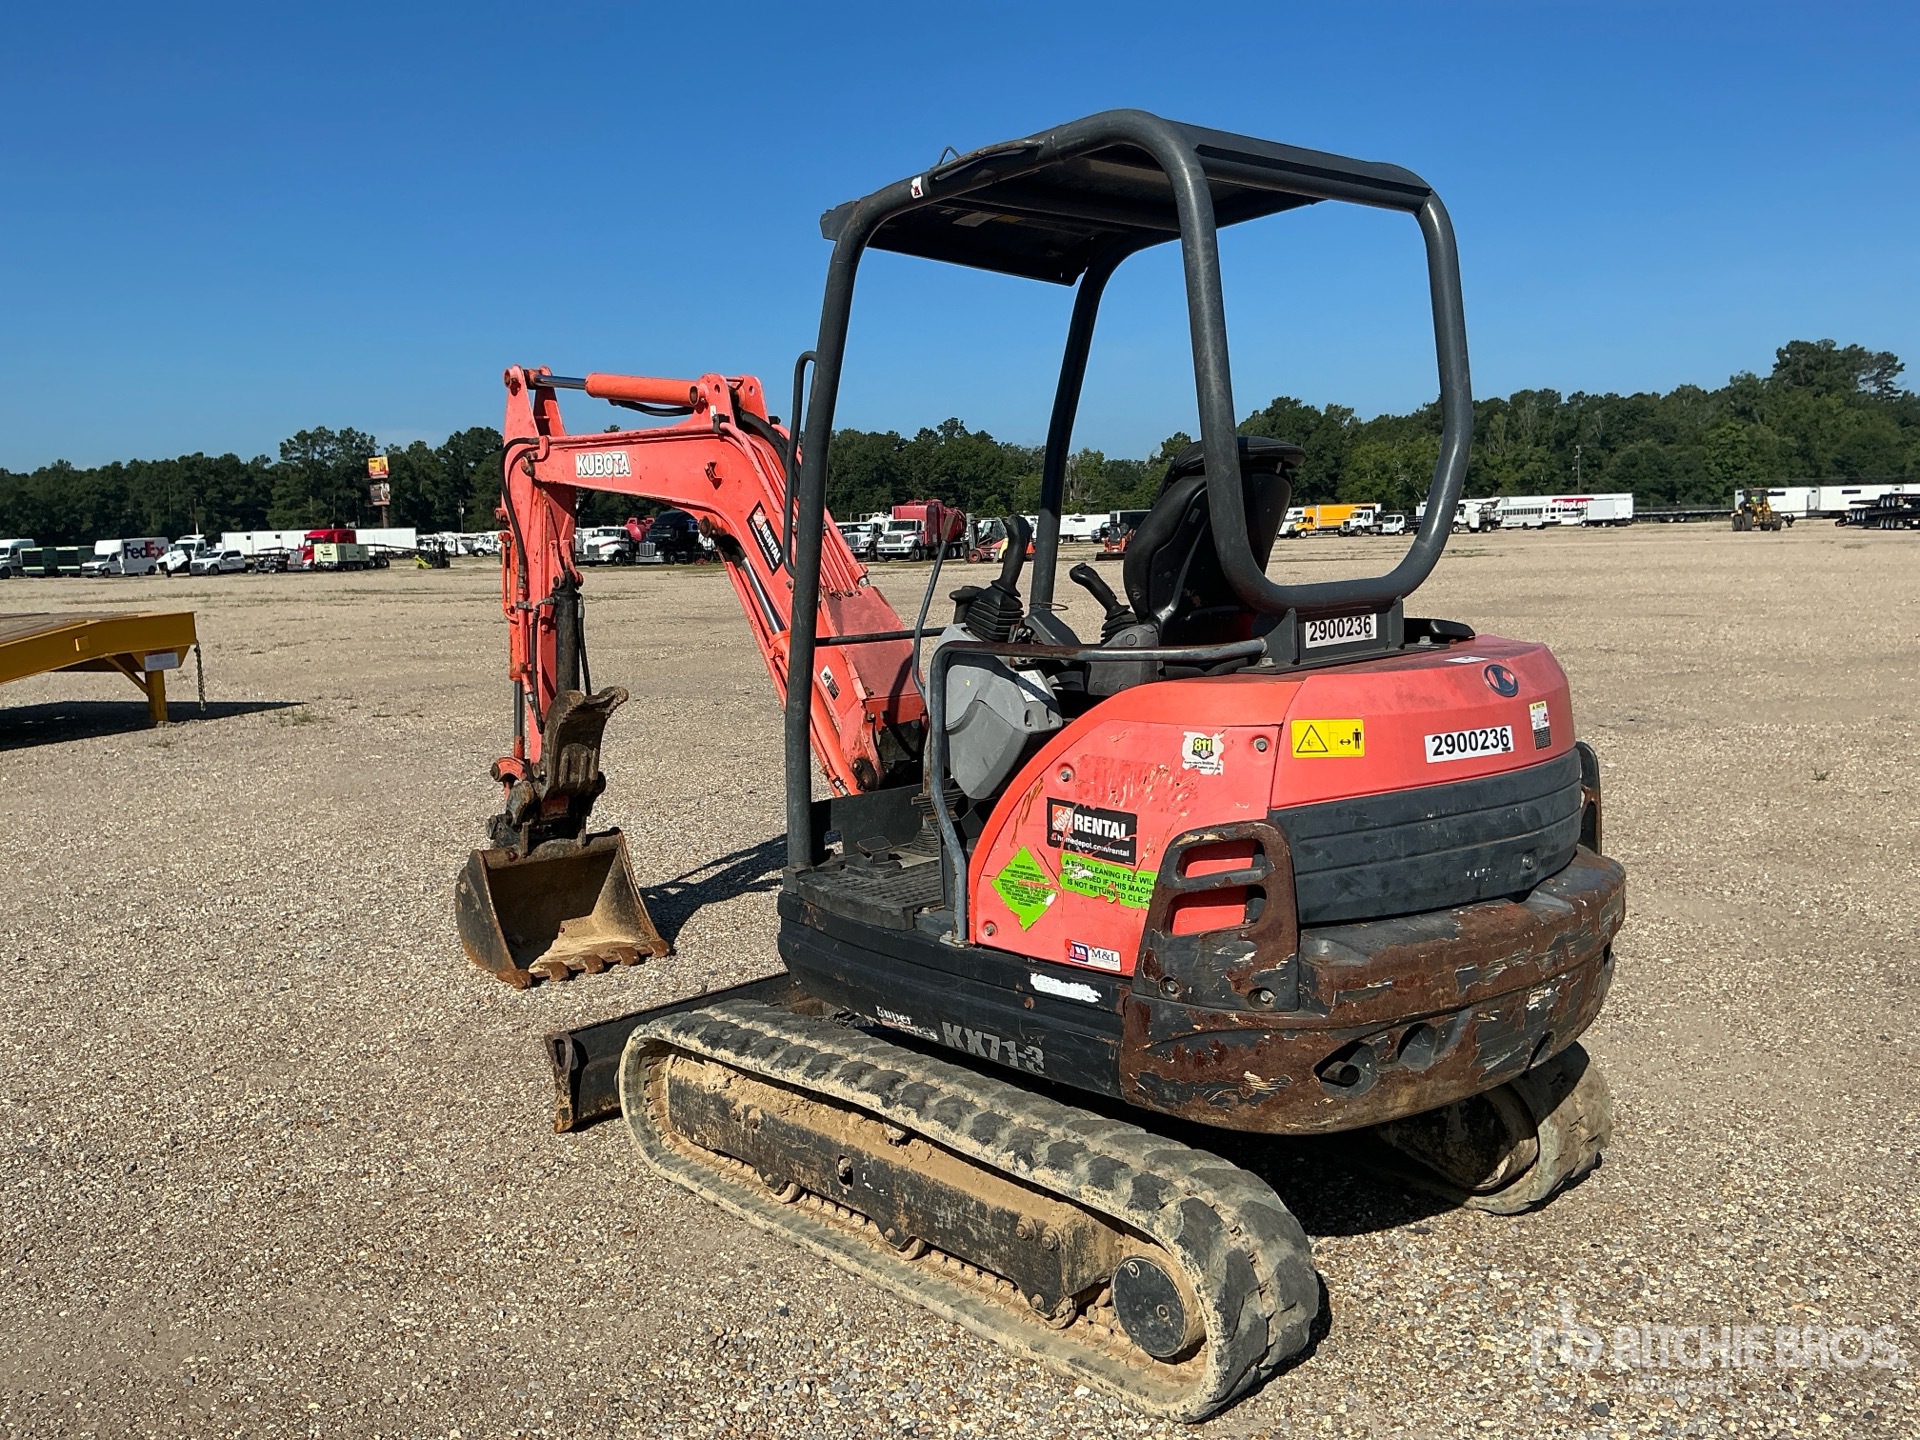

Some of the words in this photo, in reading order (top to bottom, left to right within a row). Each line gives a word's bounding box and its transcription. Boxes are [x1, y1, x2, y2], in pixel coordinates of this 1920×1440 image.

[575, 452, 631, 476] KUBOTA
[123, 541, 164, 559] FedEx
[760, 522, 781, 564] RENTAL
[1309, 615, 1372, 642] 2900236
[1193, 738, 1213, 751] 811
[1431, 727, 1510, 757] 2900236
[1074, 813, 1130, 842] RENTAL
[1086, 865, 1121, 880] CLEANING
[1122, 873, 1137, 883] FEE
[1074, 880, 1088, 889] NOT
[1089, 884, 1126, 900] RETURNED
[1091, 948, 1119, 963] M&L
[941, 1021, 1046, 1075] KX71-3
